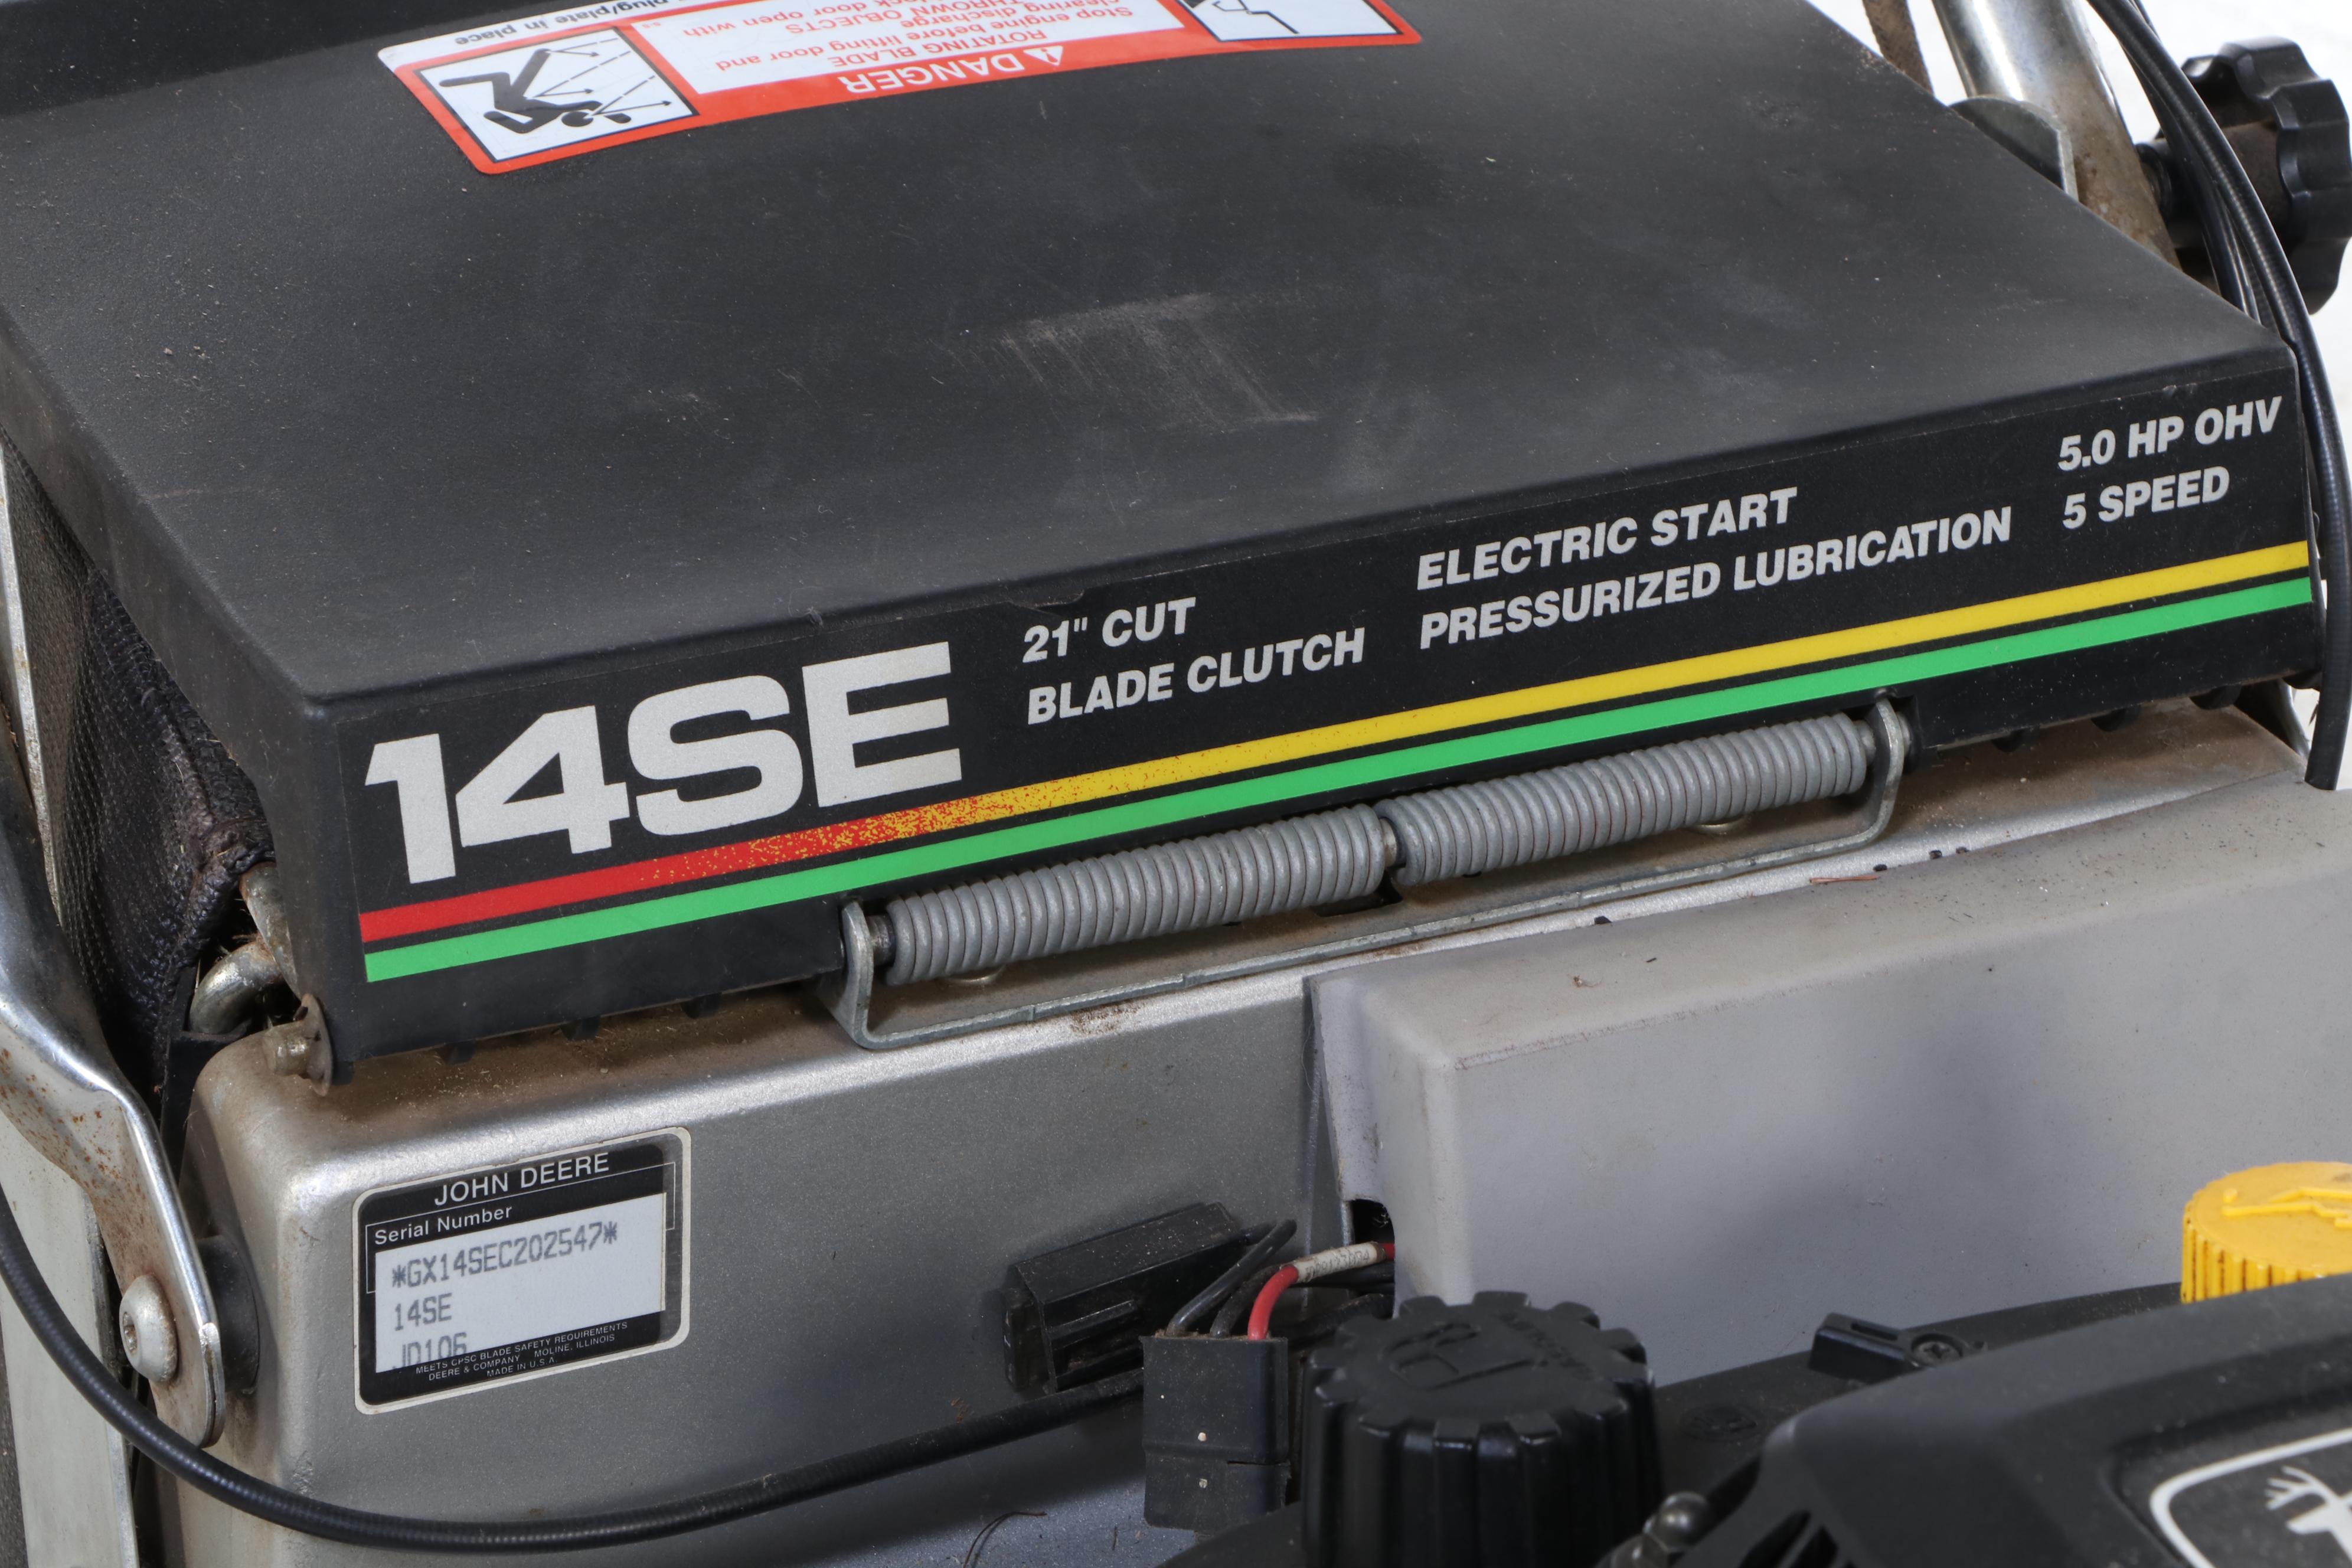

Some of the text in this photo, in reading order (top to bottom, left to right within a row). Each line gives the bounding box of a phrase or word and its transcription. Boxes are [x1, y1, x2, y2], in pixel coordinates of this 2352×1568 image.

[524, 20, 550, 29] in
[743, 11, 803, 27] open
[786, 9, 901, 34] OBJECTS
[814, 1, 867, 16] door
[900, 7, 1017, 27] discharge
[455, 24, 517, 44] place
[683, 22, 737, 37] with
[716, 6, 1133, 71] Stop engine before lifting door and
[828, 30, 1047, 67] ROTATING BLADE
[837, 53, 1025, 93] DANGER
[2057, 396, 2282, 471] 5.0 HP OHV
[2062, 466, 2230, 529] 5 SPEED
[1417, 486, 1797, 590] ELECTRIC START
[1420, 506, 2011, 649] PRESSURIZED LUBRICATION
[1022, 597, 1196, 663] 21" CUT
[1028, 627, 1366, 725] BLADE CLUTCH
[364, 641, 962, 884] 14SE
[434, 1152, 609, 1206] JOHN DEERE
[374, 1206, 512, 1245] Serial Number
[394, 1293, 453, 1331] 14SE
[416, 1321, 628, 1374] MEETS CPSC BLADE SAFETY REQUIREMENTS
[429, 1367, 460, 1381] DEERE
[463, 1365, 471, 1373] &
[473, 1354, 520, 1371] COMPANY
[576, 1334, 615, 1349] ILLINOIS
[486, 1366, 515, 1378] MADE
